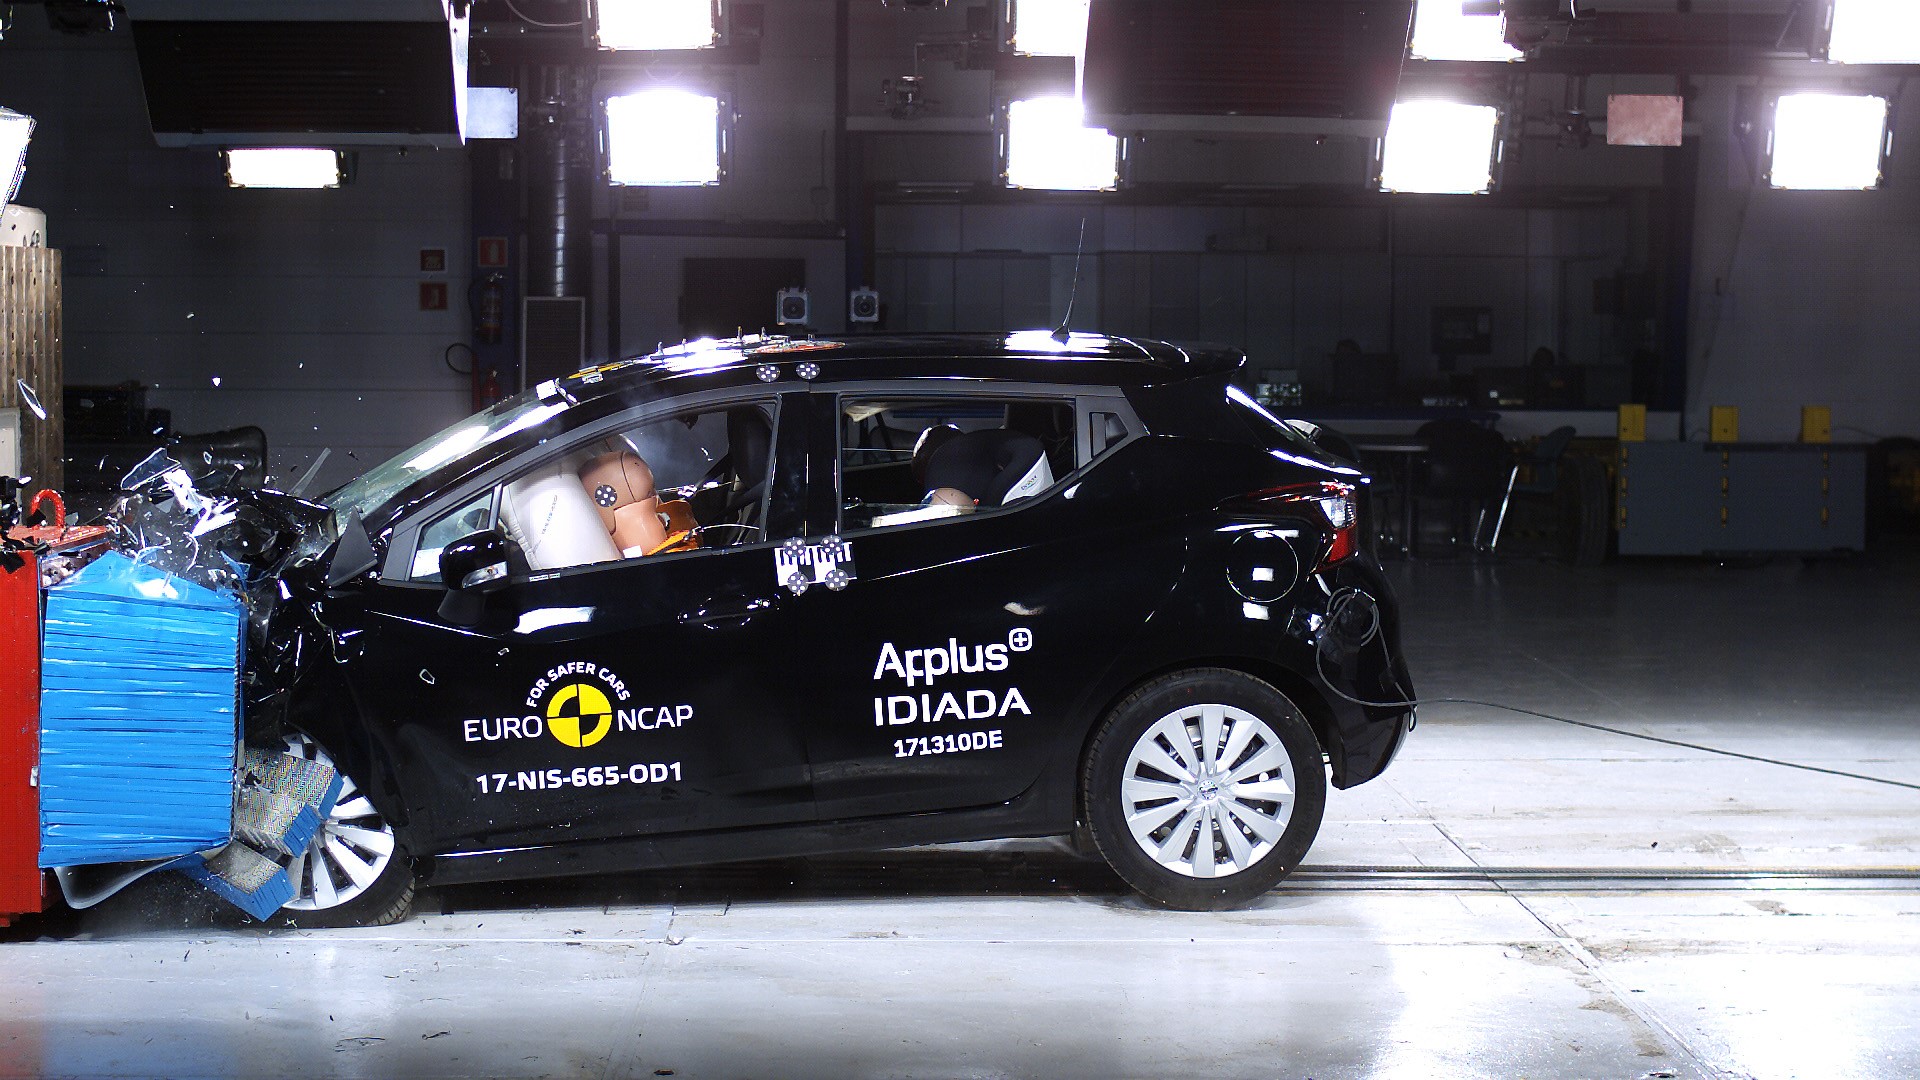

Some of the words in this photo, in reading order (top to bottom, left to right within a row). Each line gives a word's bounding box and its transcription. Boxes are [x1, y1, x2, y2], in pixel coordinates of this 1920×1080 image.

[526, 678, 549, 708] FOR
[547, 661, 596, 682] SAFER
[598, 668, 631, 701] CARS
[463, 715, 543, 742] EURO
[617, 704, 694, 732] NCAP
[873, 687, 1032, 727] IDIADA
[893, 729, 1003, 758] 171310DE
